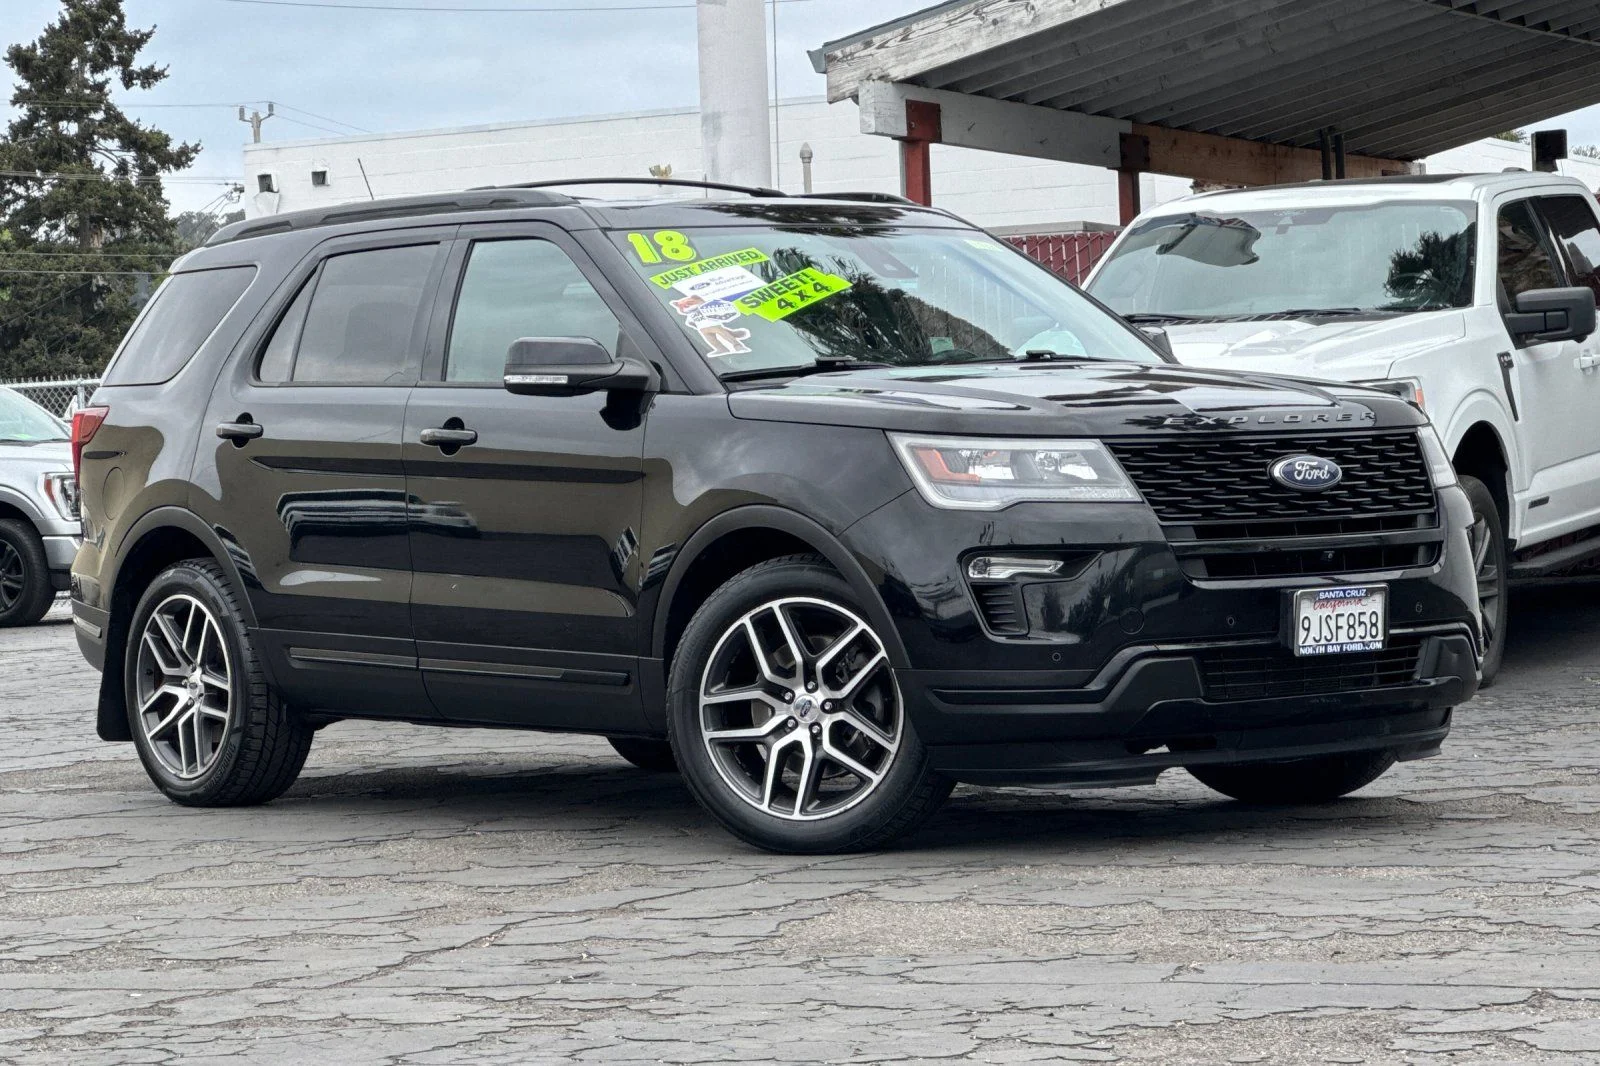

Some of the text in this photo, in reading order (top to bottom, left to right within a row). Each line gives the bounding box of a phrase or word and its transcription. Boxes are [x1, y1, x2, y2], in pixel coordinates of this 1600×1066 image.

[627, 230, 697, 265] 18
[660, 267, 697, 286] JUST
[698, 250, 761, 276] ARRIVED
[740, 271, 818, 309] SWEET!
[777, 297, 796, 311] 4
[813, 281, 831, 293] 4
[1163, 411, 1376, 425] EXPLORER
[1293, 460, 1331, 481] Ford
[1320, 589, 1367, 600] SANTA CRUZ
[1301, 611, 1379, 645] 9JSF858
[1327, 644, 1341, 653] BAY
